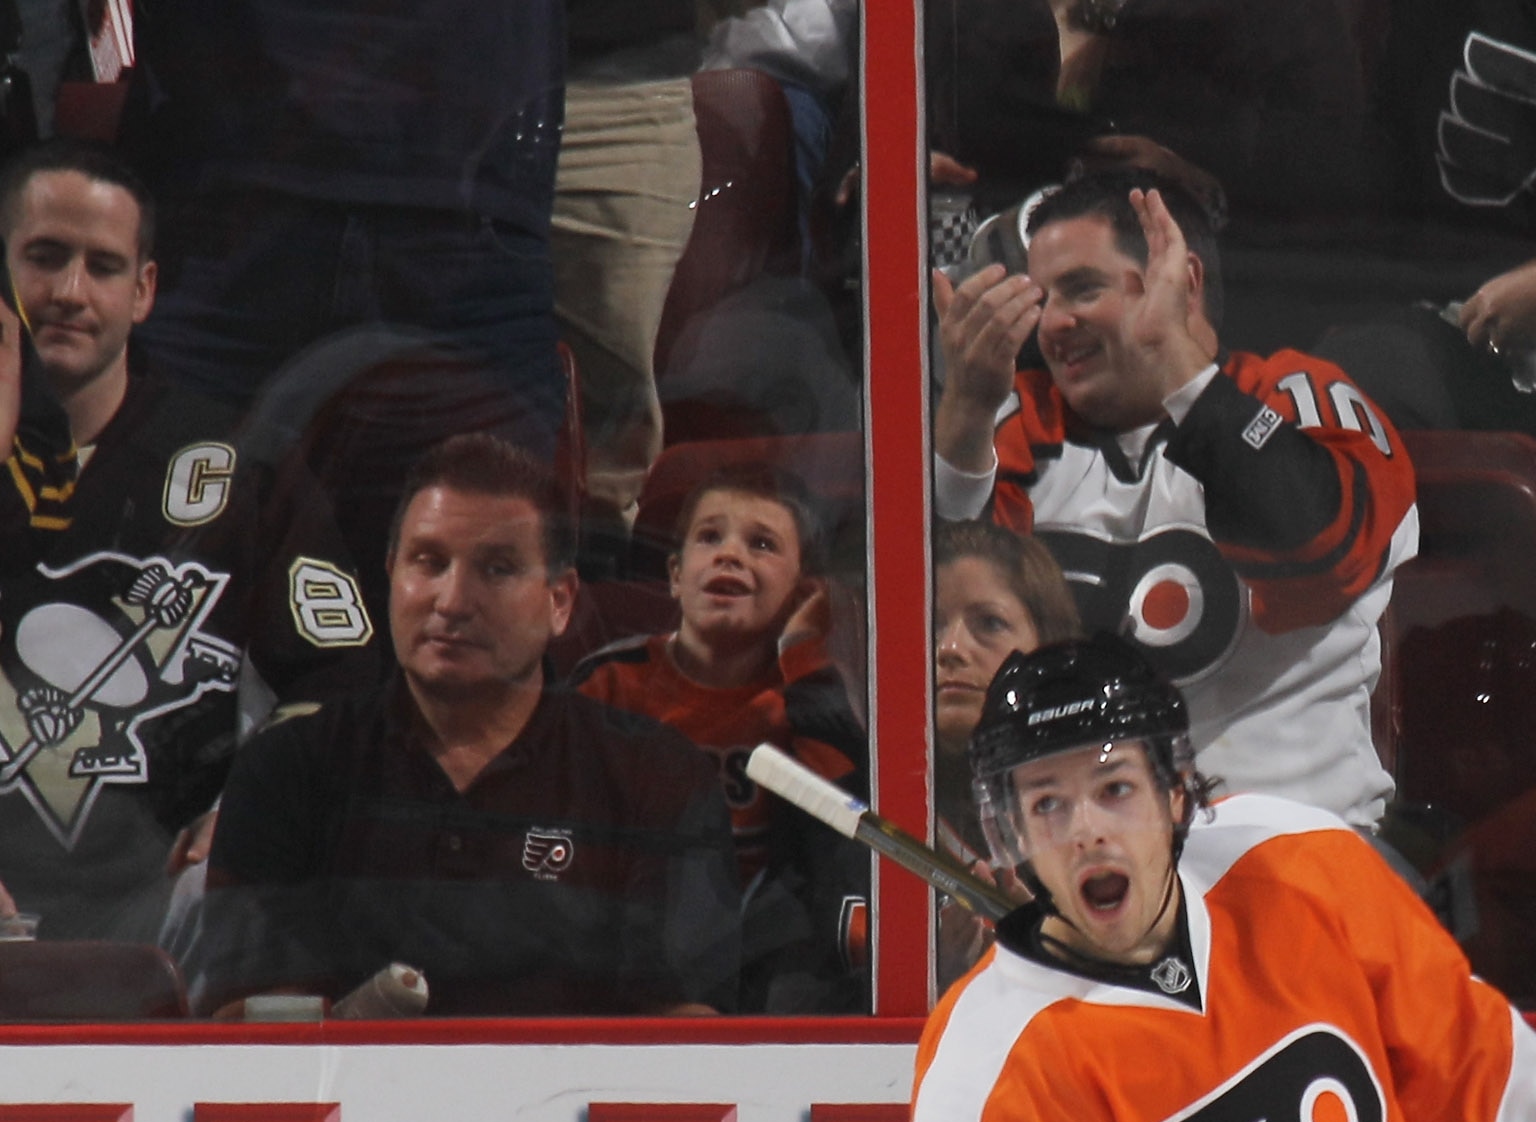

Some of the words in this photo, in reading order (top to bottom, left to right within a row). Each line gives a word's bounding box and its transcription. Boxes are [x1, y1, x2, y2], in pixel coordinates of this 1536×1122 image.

[1277, 367, 1391, 457] 10
[162, 442, 236, 527] C
[289, 556, 374, 647] 8
[1027, 699, 1095, 726] BAUER
